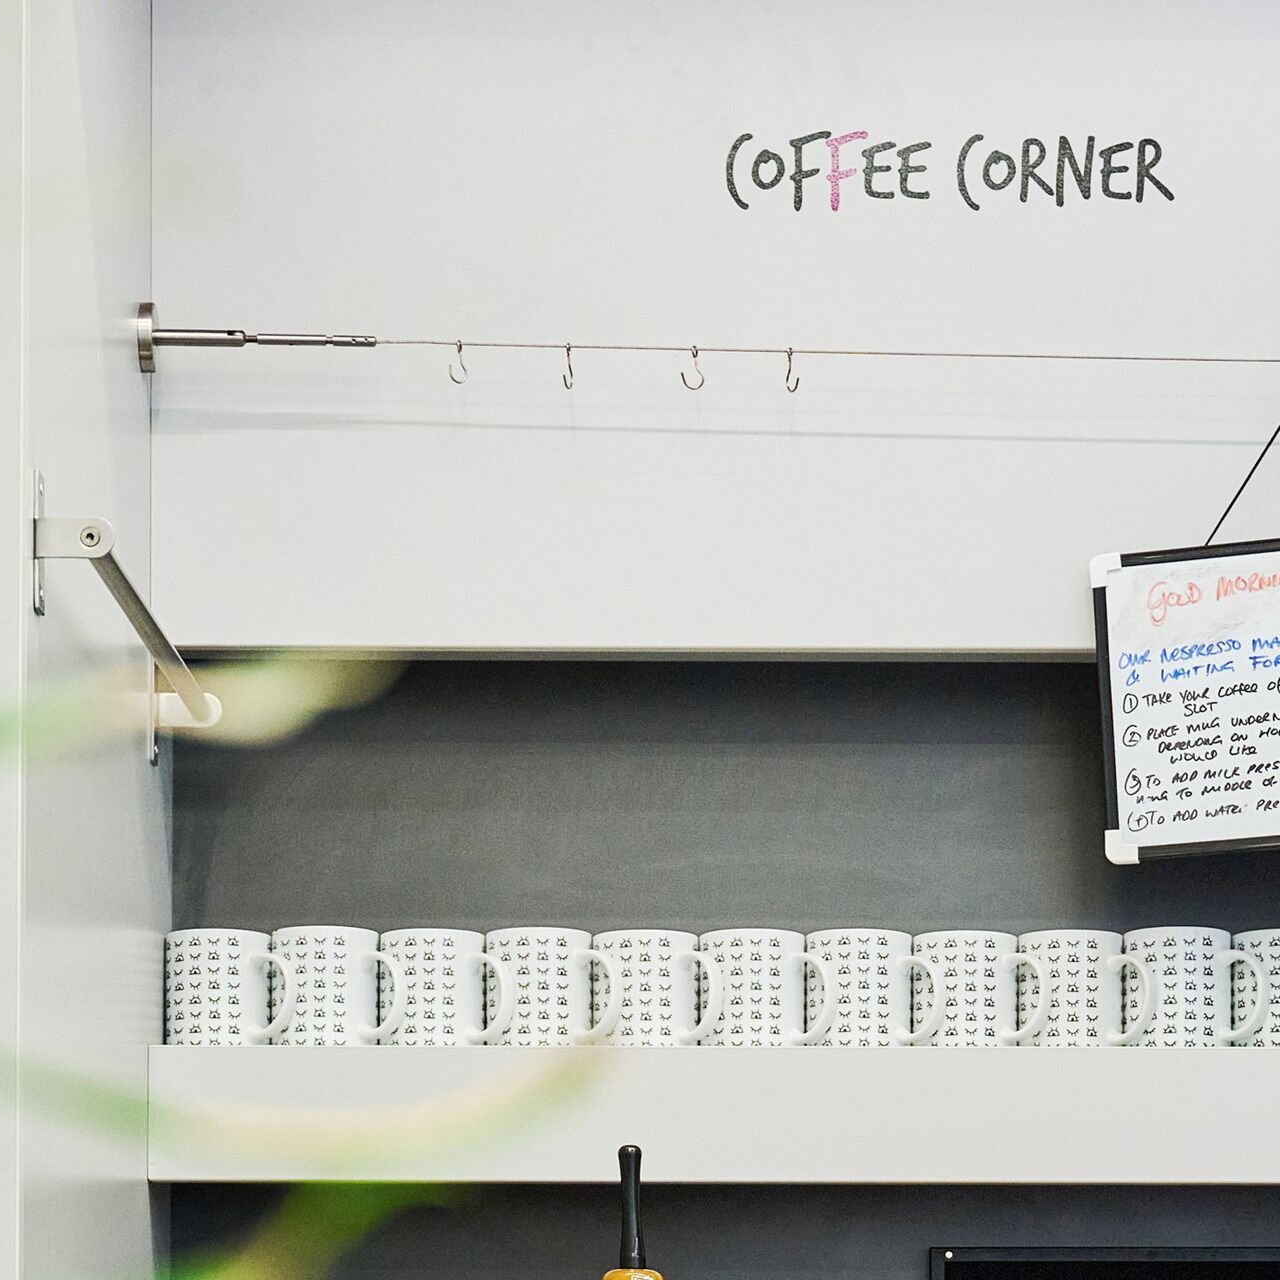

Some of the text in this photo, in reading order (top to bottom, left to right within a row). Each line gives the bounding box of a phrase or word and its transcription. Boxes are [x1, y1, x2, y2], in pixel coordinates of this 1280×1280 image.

[726, 131, 1174, 211] COFFEE CORNER
[1183, 701, 1218, 718] SLOT
[1171, 770, 1198, 784] ADD
[1172, 809, 1198, 823] ADD
